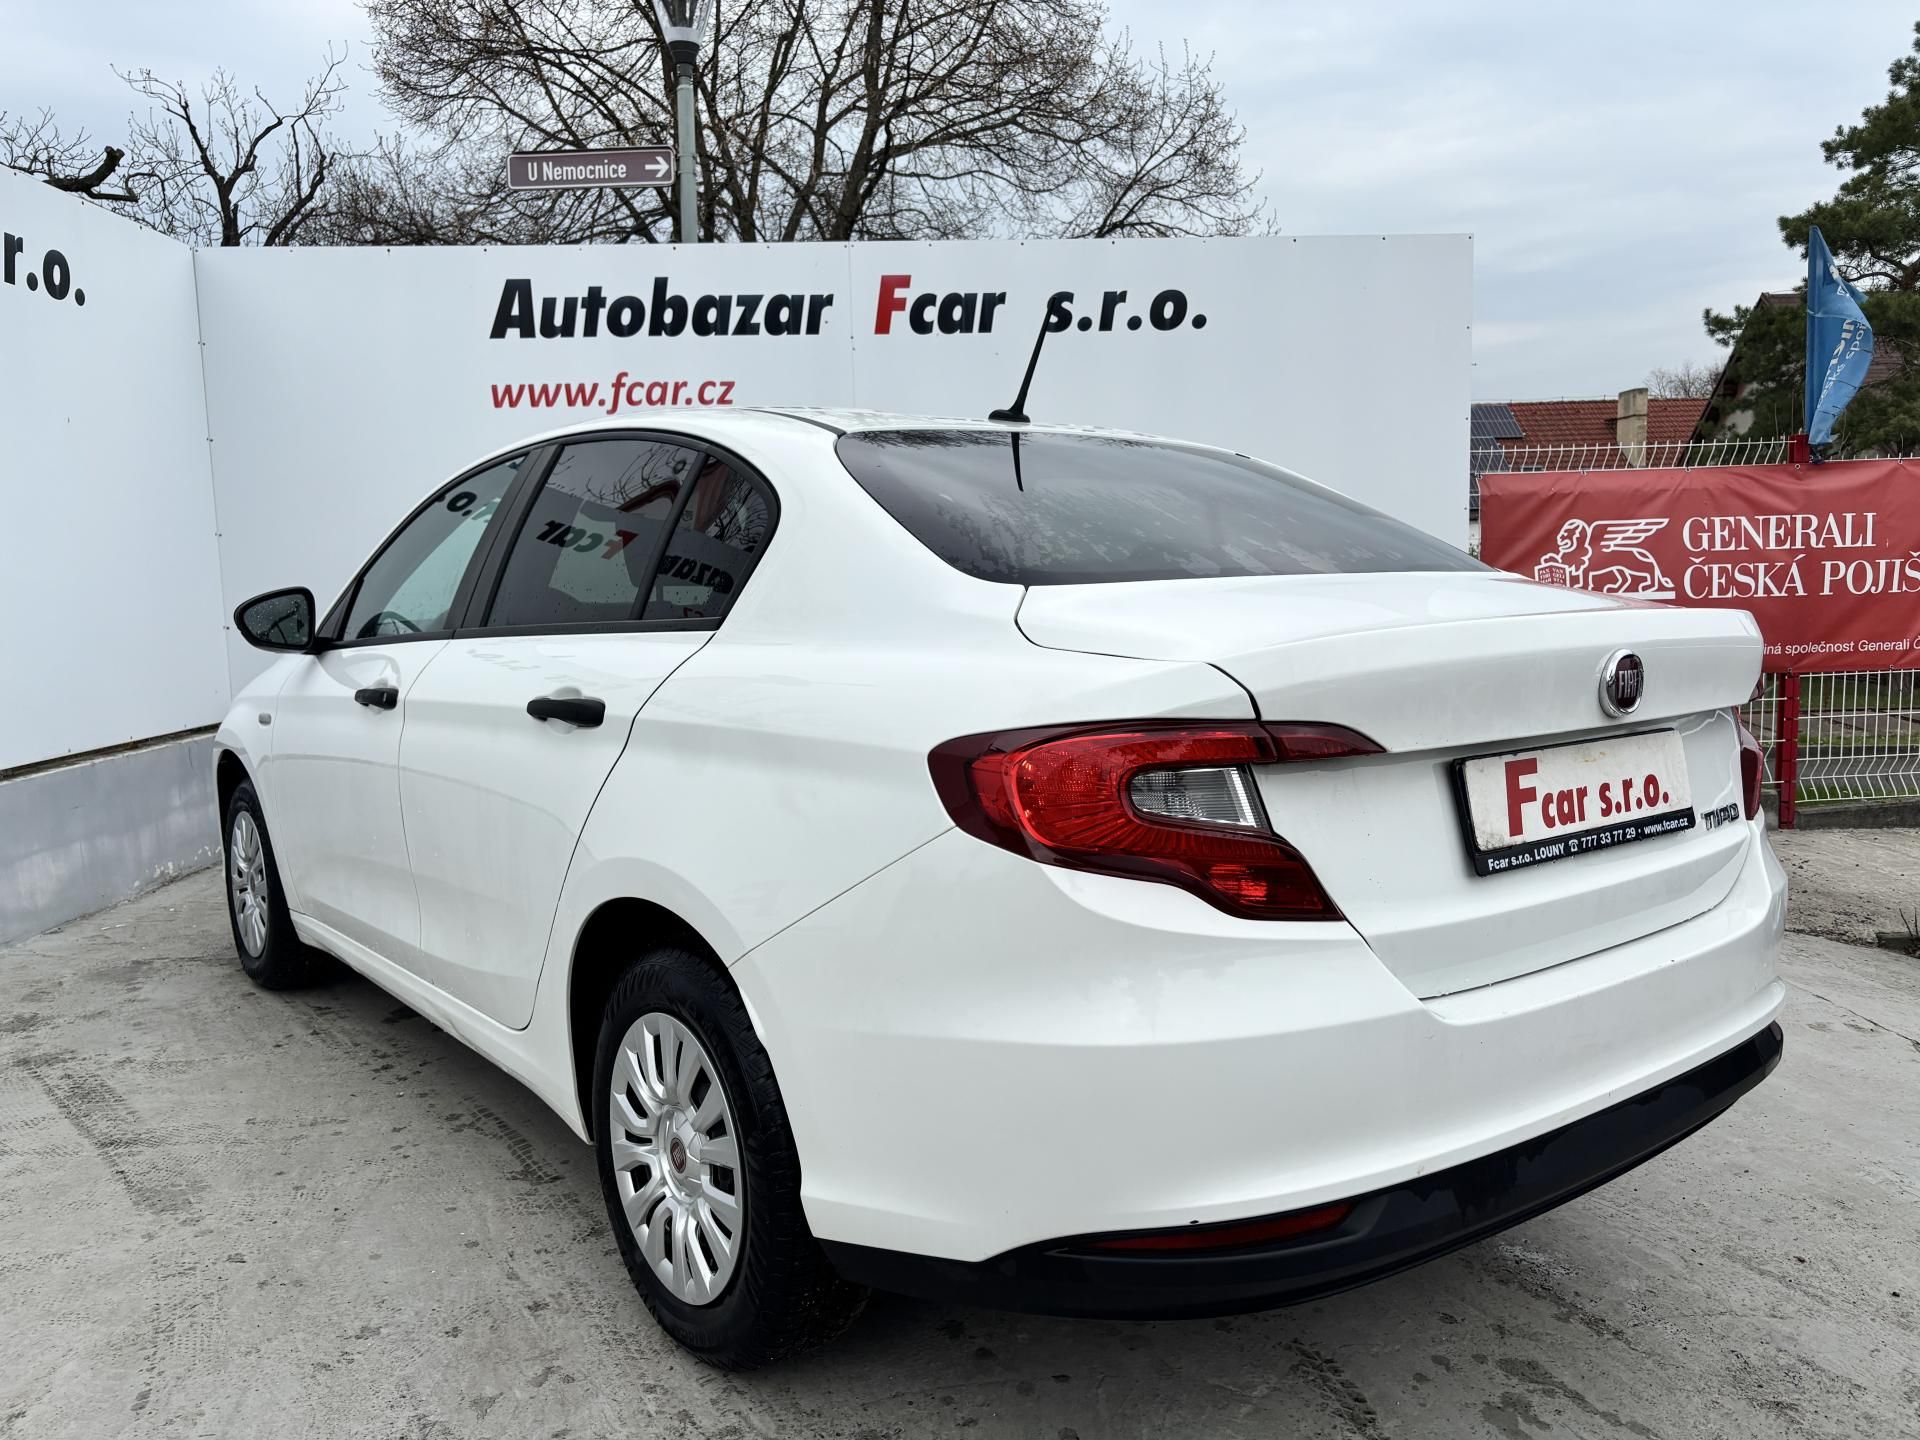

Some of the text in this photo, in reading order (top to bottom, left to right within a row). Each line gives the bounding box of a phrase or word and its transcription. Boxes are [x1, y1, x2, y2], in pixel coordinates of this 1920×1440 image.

[527, 160, 627, 181] U Nemocnice
[4, 231, 86, 307] r.o.
[489, 274, 1208, 339] Autobazar Fcar s.r.o.
[491, 371, 736, 415] www.fcar.cz
[1682, 512, 1877, 551] GENERALI
[1683, 553, 1808, 599] ČESKÁ
[1785, 641, 1854, 656] společnost
[1858, 638, 1910, 651] Generali
[1618, 669, 1638, 698] FIAT
[1504, 757, 1670, 838] Fcar s.r.o.
[1488, 817, 1689, 871] Fcar s.r.o. LOUNY 777 33 77 29 www.fcar.cz
